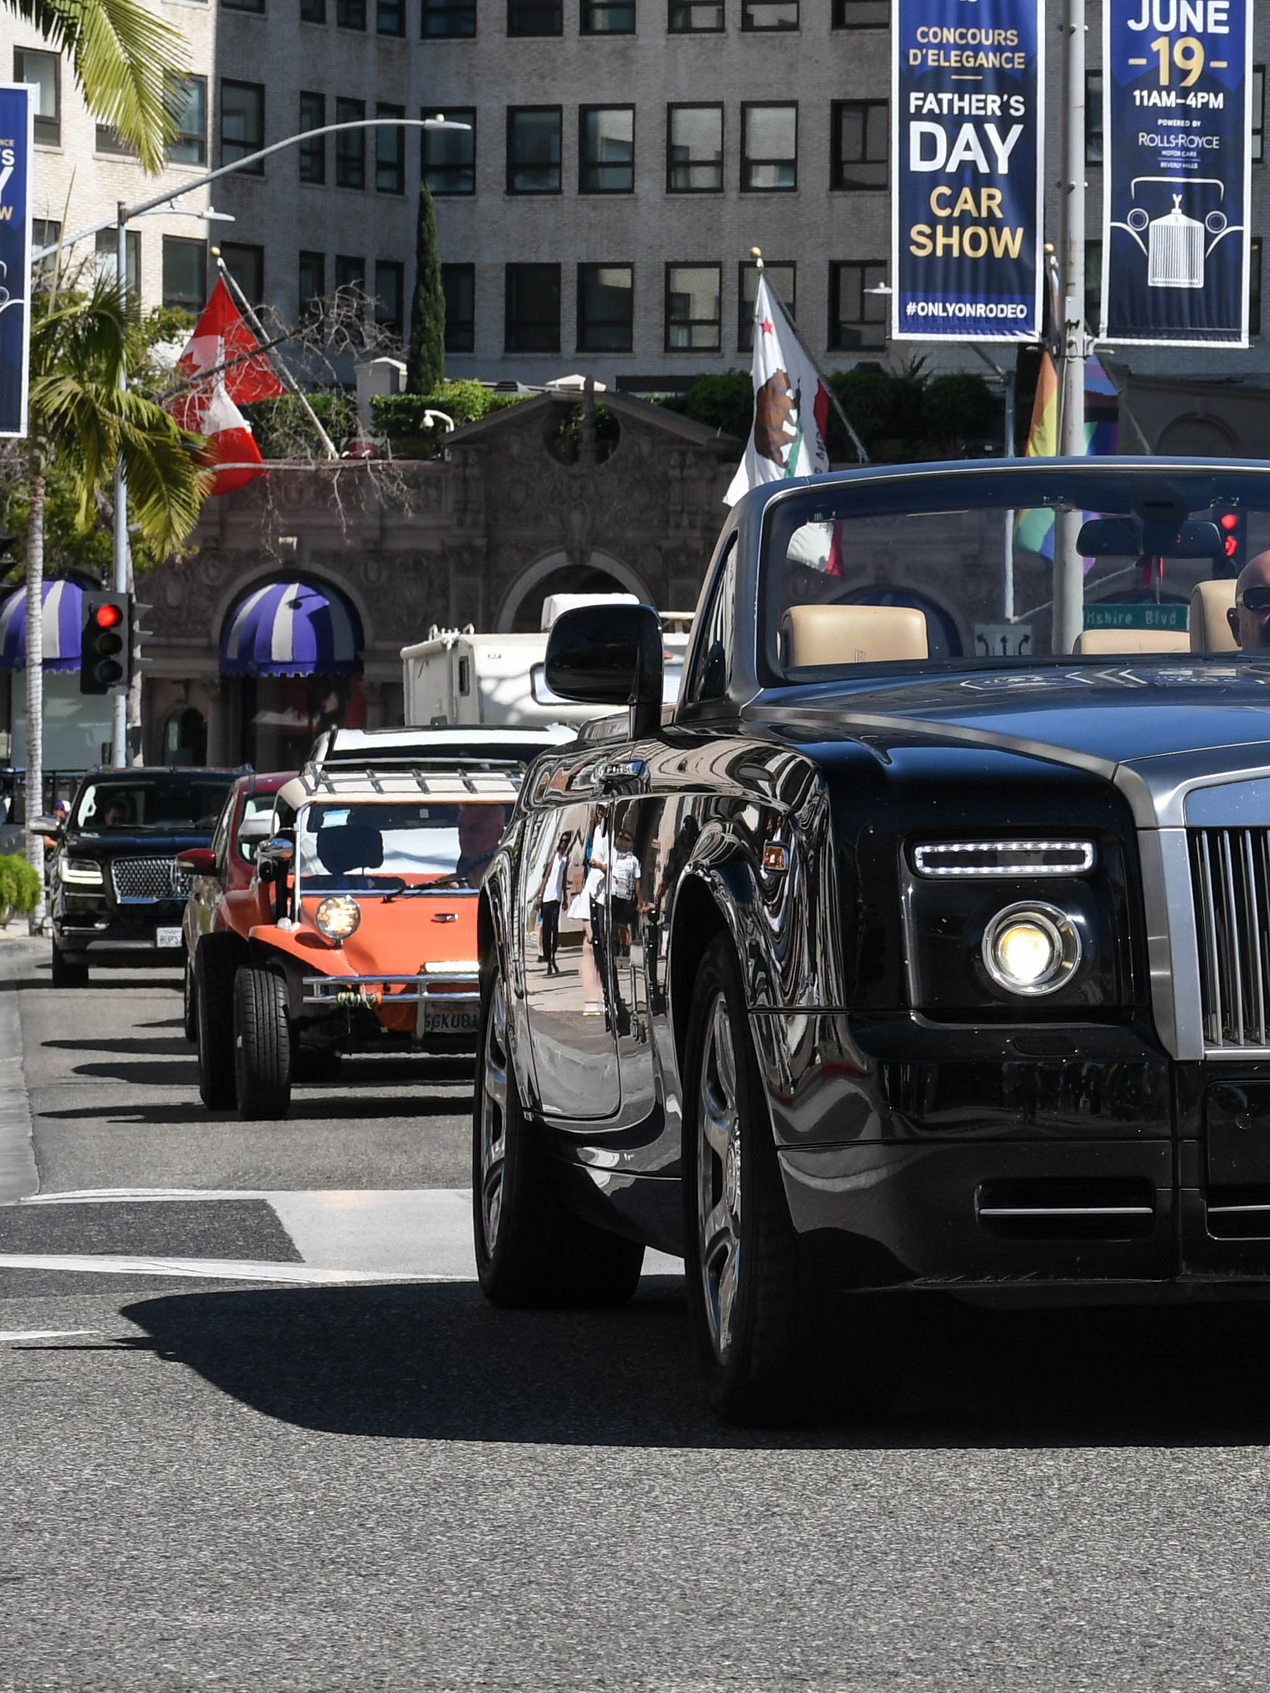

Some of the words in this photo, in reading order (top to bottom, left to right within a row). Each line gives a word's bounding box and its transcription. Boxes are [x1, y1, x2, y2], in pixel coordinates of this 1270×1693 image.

[1127, 0, 1230, 34] JUNE
[916, 26, 1018, 46] CONCOURS
[909, 49, 1026, 69] D'ELEGANCE
[909, 91, 1026, 117] FATHER'S
[1157, 118, 1190, 128] POWERED
[1192, 120, 1201, 128] BY
[909, 120, 1024, 175] DAY
[1138, 132, 1220, 149] ROLLS-ROYCE
[930, 185, 1004, 218] CAR
[909, 223, 1024, 259] SHOW
[906, 302, 1028, 319] #ONLYONRODEO
[1145, 610, 1177, 625] Blvd
